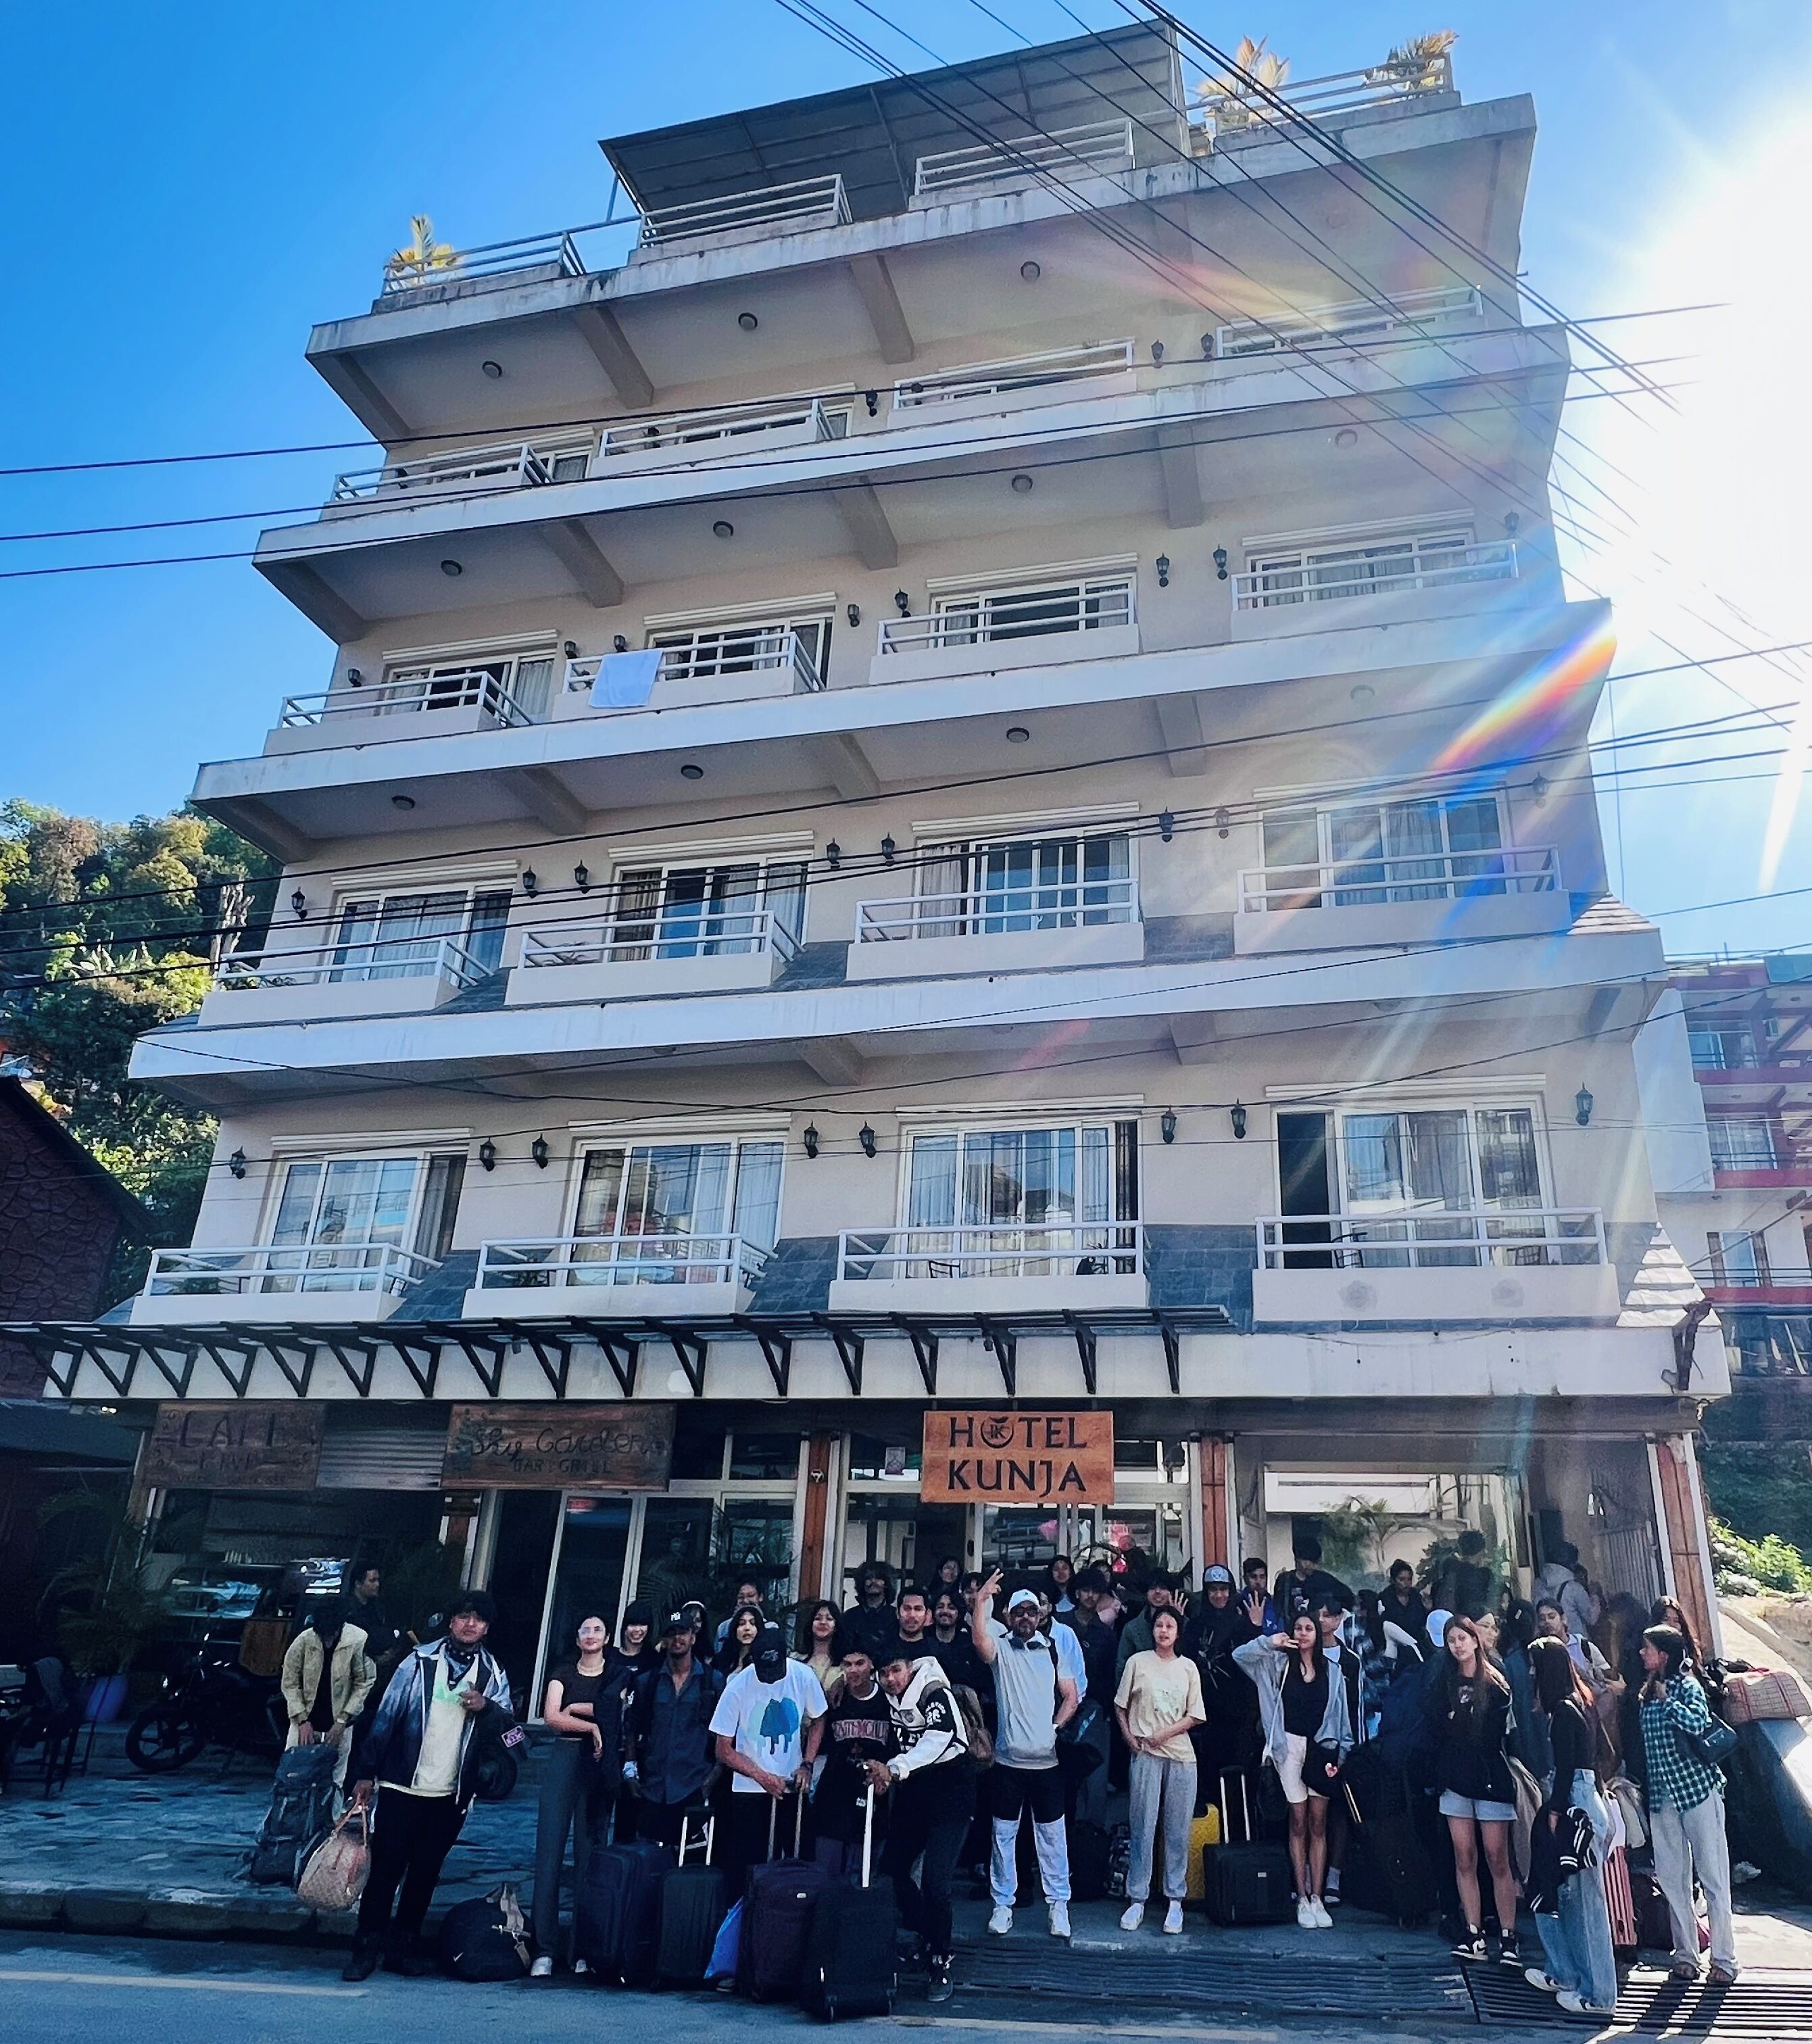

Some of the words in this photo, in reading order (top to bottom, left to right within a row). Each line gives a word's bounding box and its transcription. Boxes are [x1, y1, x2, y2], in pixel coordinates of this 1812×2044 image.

[949, 1416, 1087, 1449] HOTEL
[559, 1458, 614, 1474] GRILL
[948, 1459, 1087, 1498] KUNJA
